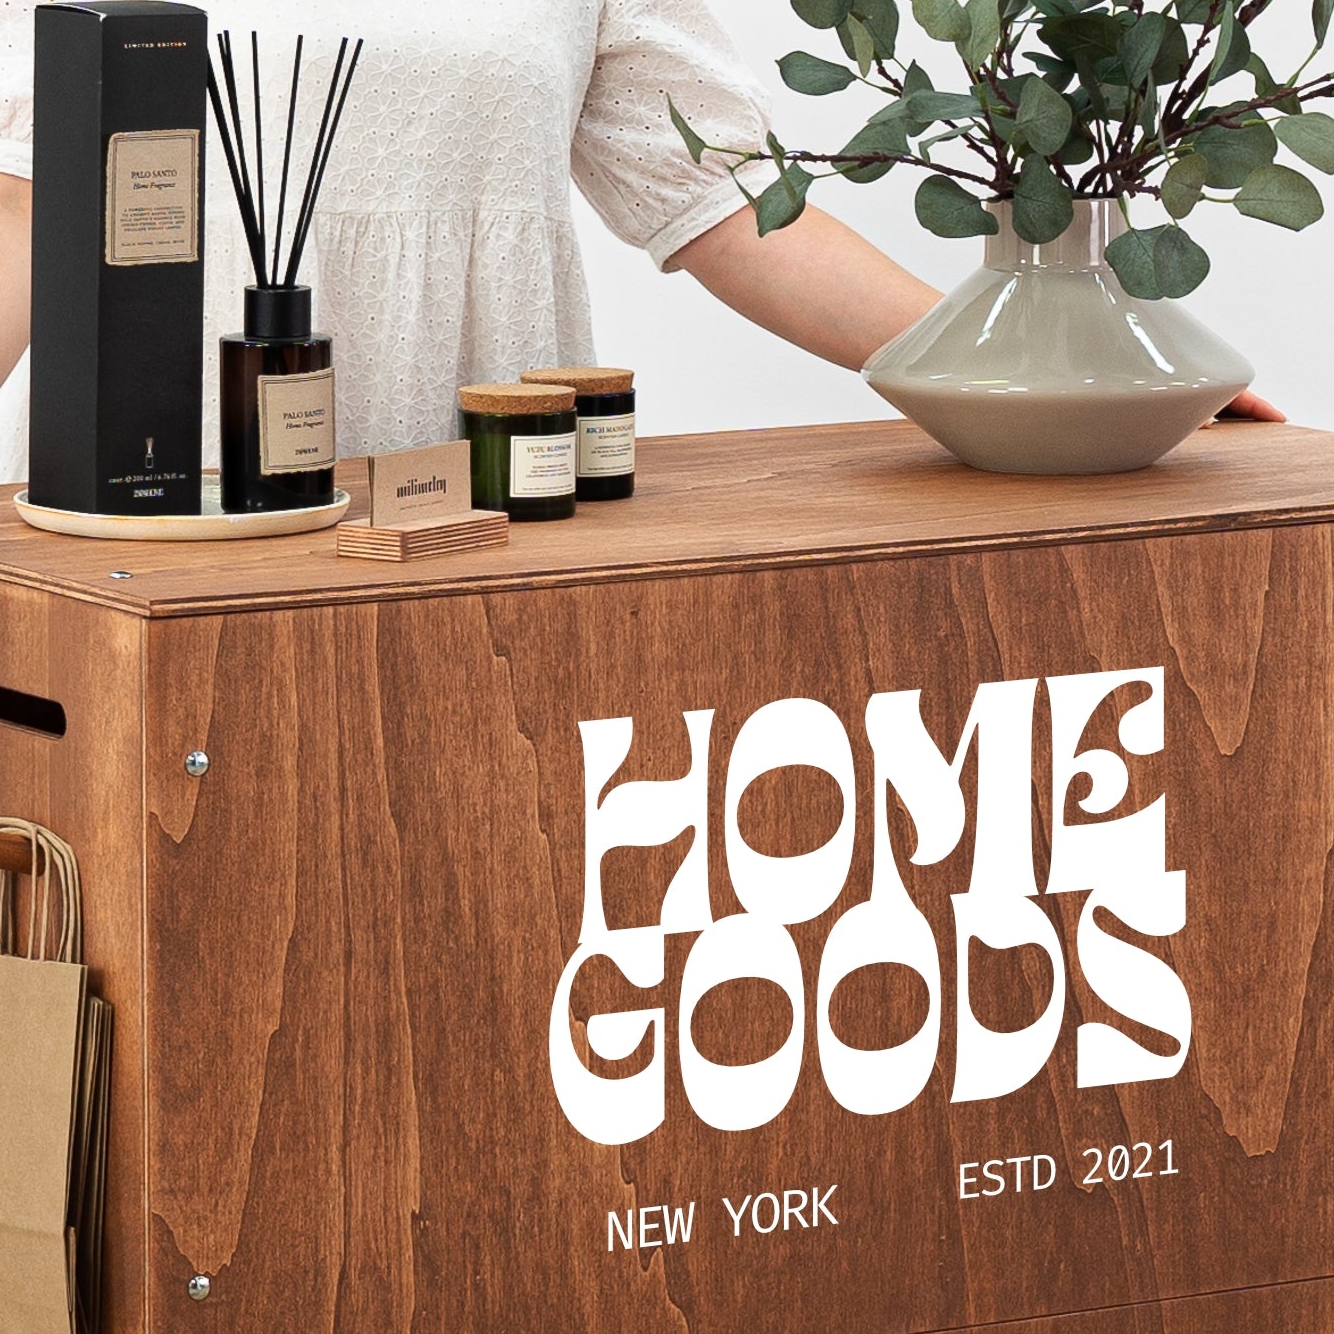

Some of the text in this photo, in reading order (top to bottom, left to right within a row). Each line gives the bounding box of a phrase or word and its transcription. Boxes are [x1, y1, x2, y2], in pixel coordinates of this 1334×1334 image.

[130, 169, 177, 179] PALO SANTO
[578, 666, 1165, 944] HOME
[549, 870, 1192, 1146] GOODS
[957, 1138, 1179, 1199] ESTD 2021
[606, 1184, 839, 1252] NEW YORK
